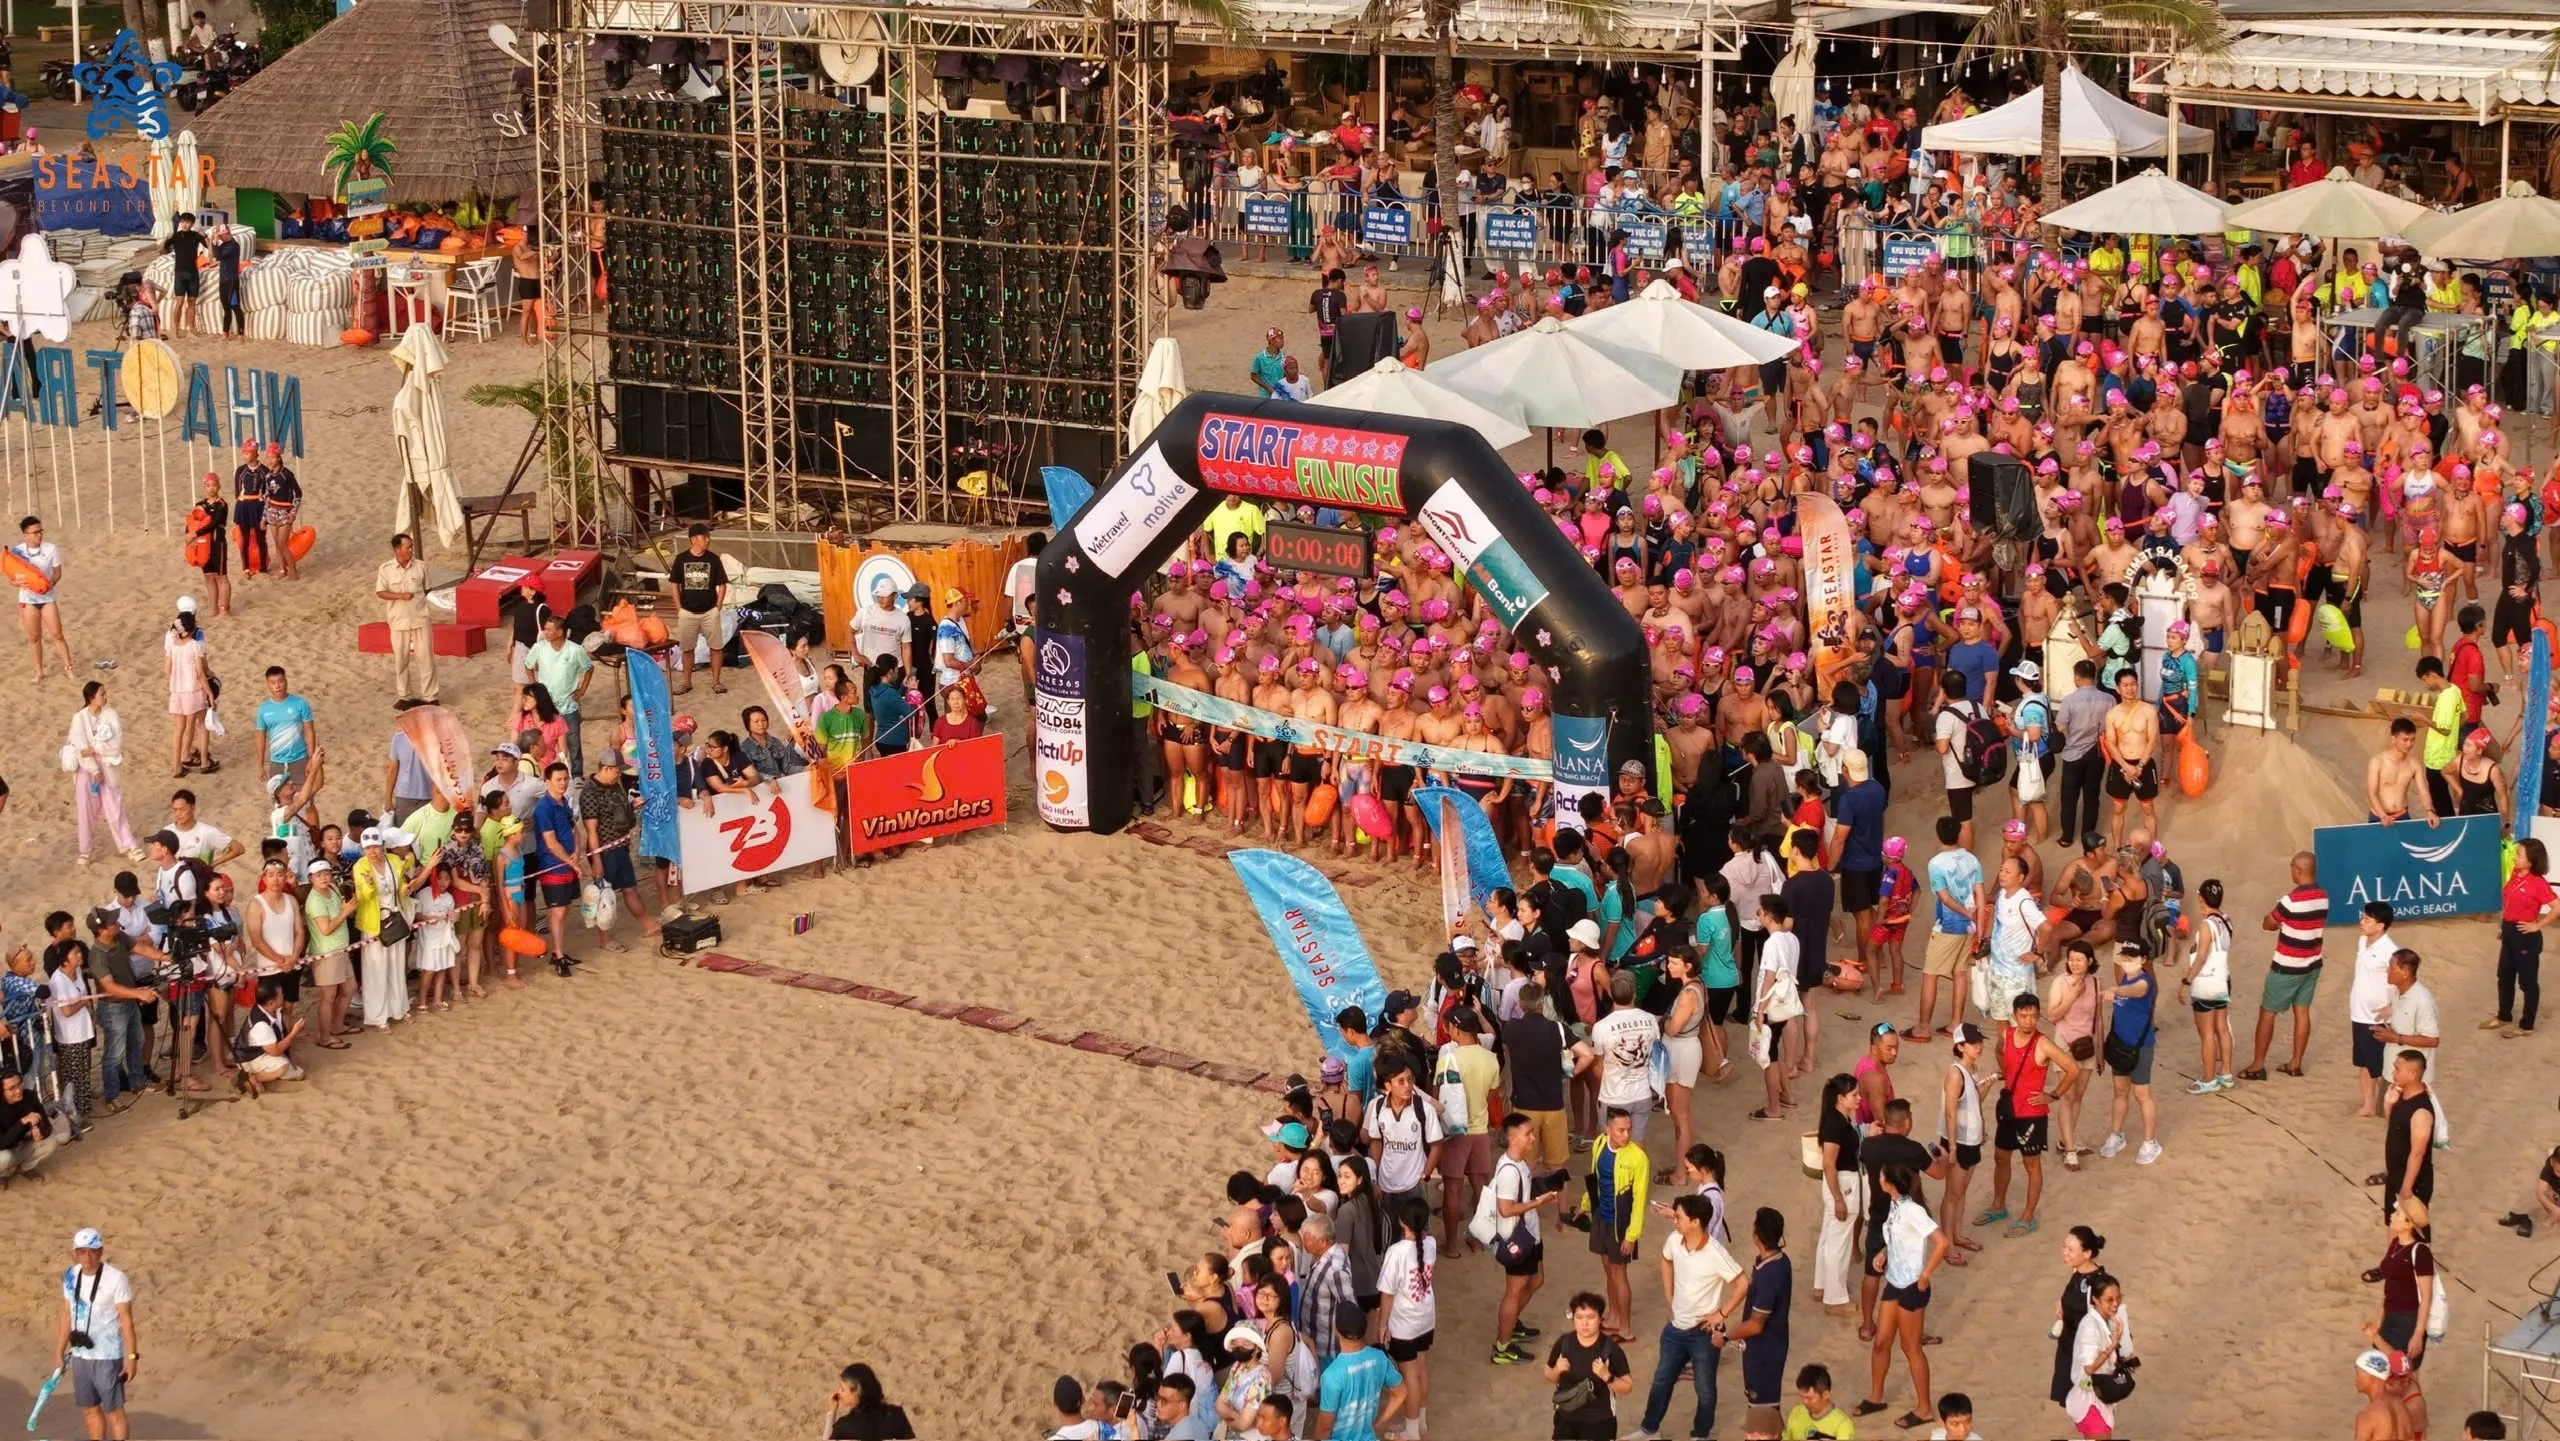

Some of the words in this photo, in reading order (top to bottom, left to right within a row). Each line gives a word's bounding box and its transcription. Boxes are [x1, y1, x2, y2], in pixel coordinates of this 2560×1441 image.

[1493, 219, 1504, 227] KHU
[1517, 218, 1530, 228] CẤM
[2489, 285, 2504, 293] KHU
[1200, 418, 1301, 468] START
[1294, 457, 1403, 509] FINISH
[1143, 484, 1186, 528] motive
[1088, 511, 1129, 554] Vietravel
[1270, 533, 1362, 569] 0:00:00
[489, 569, 525, 577] 1
[1820, 534, 1838, 605] SEASTAR
[1312, 729, 1403, 766] START
[862, 800, 993, 838] VinWonders
[2346, 870, 2470, 905] ALANA
[2393, 906, 2420, 917] RANG
[2424, 903, 2457, 914] BEACH
[1285, 908, 1335, 988] SEASTAR
